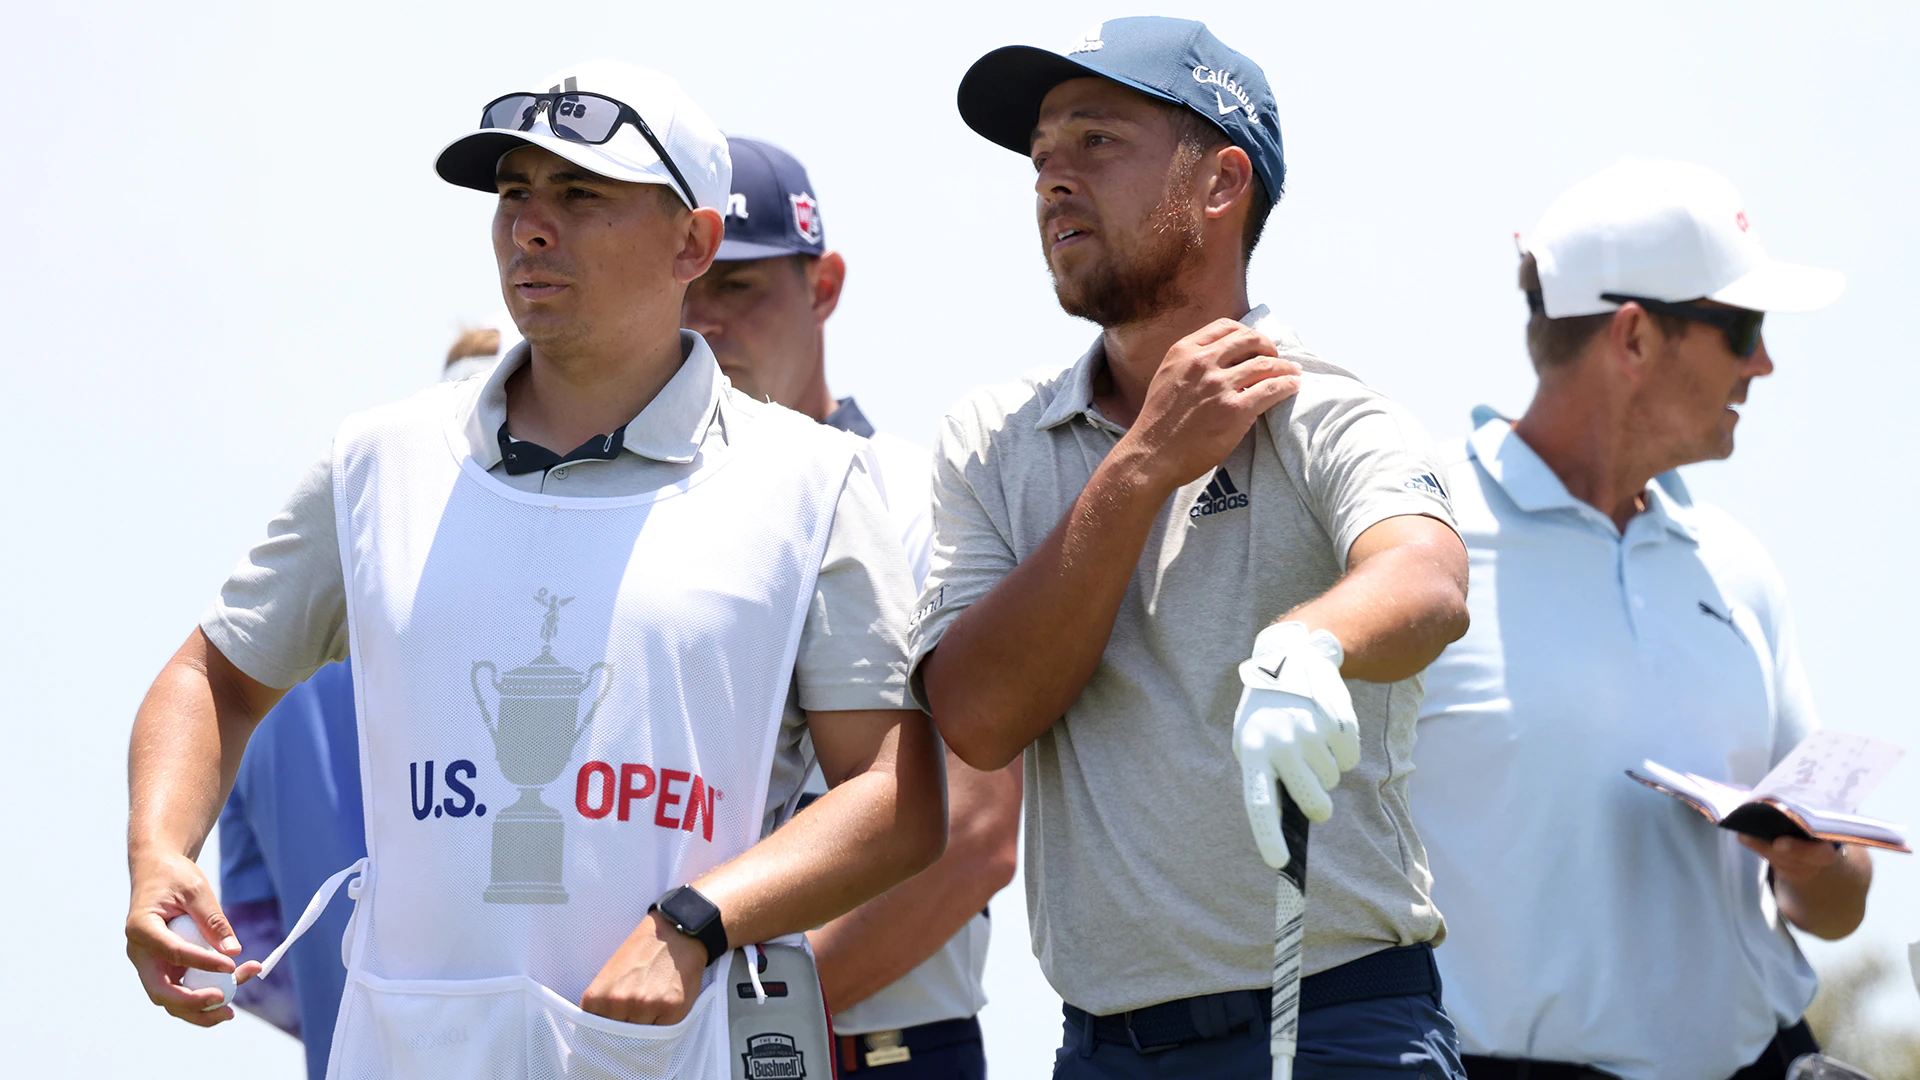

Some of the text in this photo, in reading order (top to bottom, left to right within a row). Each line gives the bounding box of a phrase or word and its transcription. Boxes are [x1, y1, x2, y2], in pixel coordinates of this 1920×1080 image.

[1192, 65, 1260, 124] Callaway
[1189, 493, 1249, 518] adidas
[410, 759, 487, 821] U.S.
[753, 1059, 798, 1078] Bushnell
